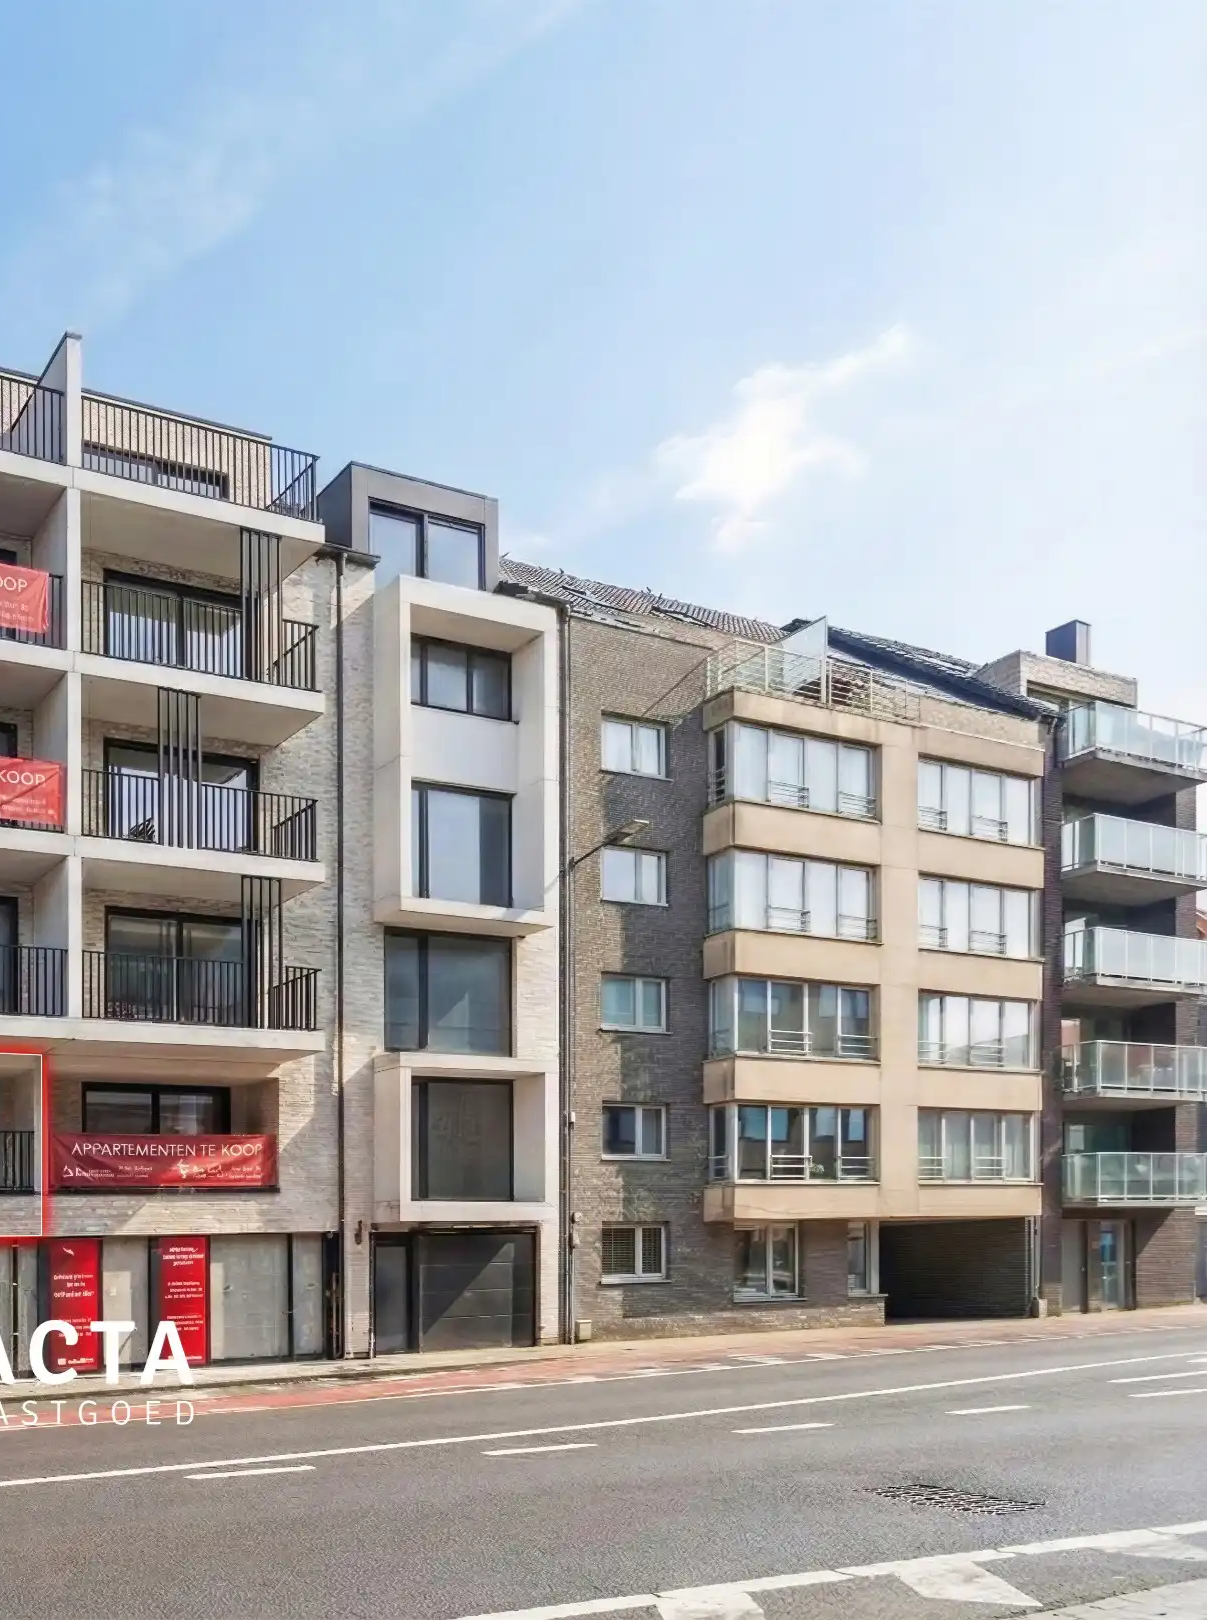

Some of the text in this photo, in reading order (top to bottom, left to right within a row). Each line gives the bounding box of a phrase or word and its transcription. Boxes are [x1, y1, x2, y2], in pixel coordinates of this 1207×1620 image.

[71, 1142, 263, 1157] APPARTEMENTEN TE KOOP
